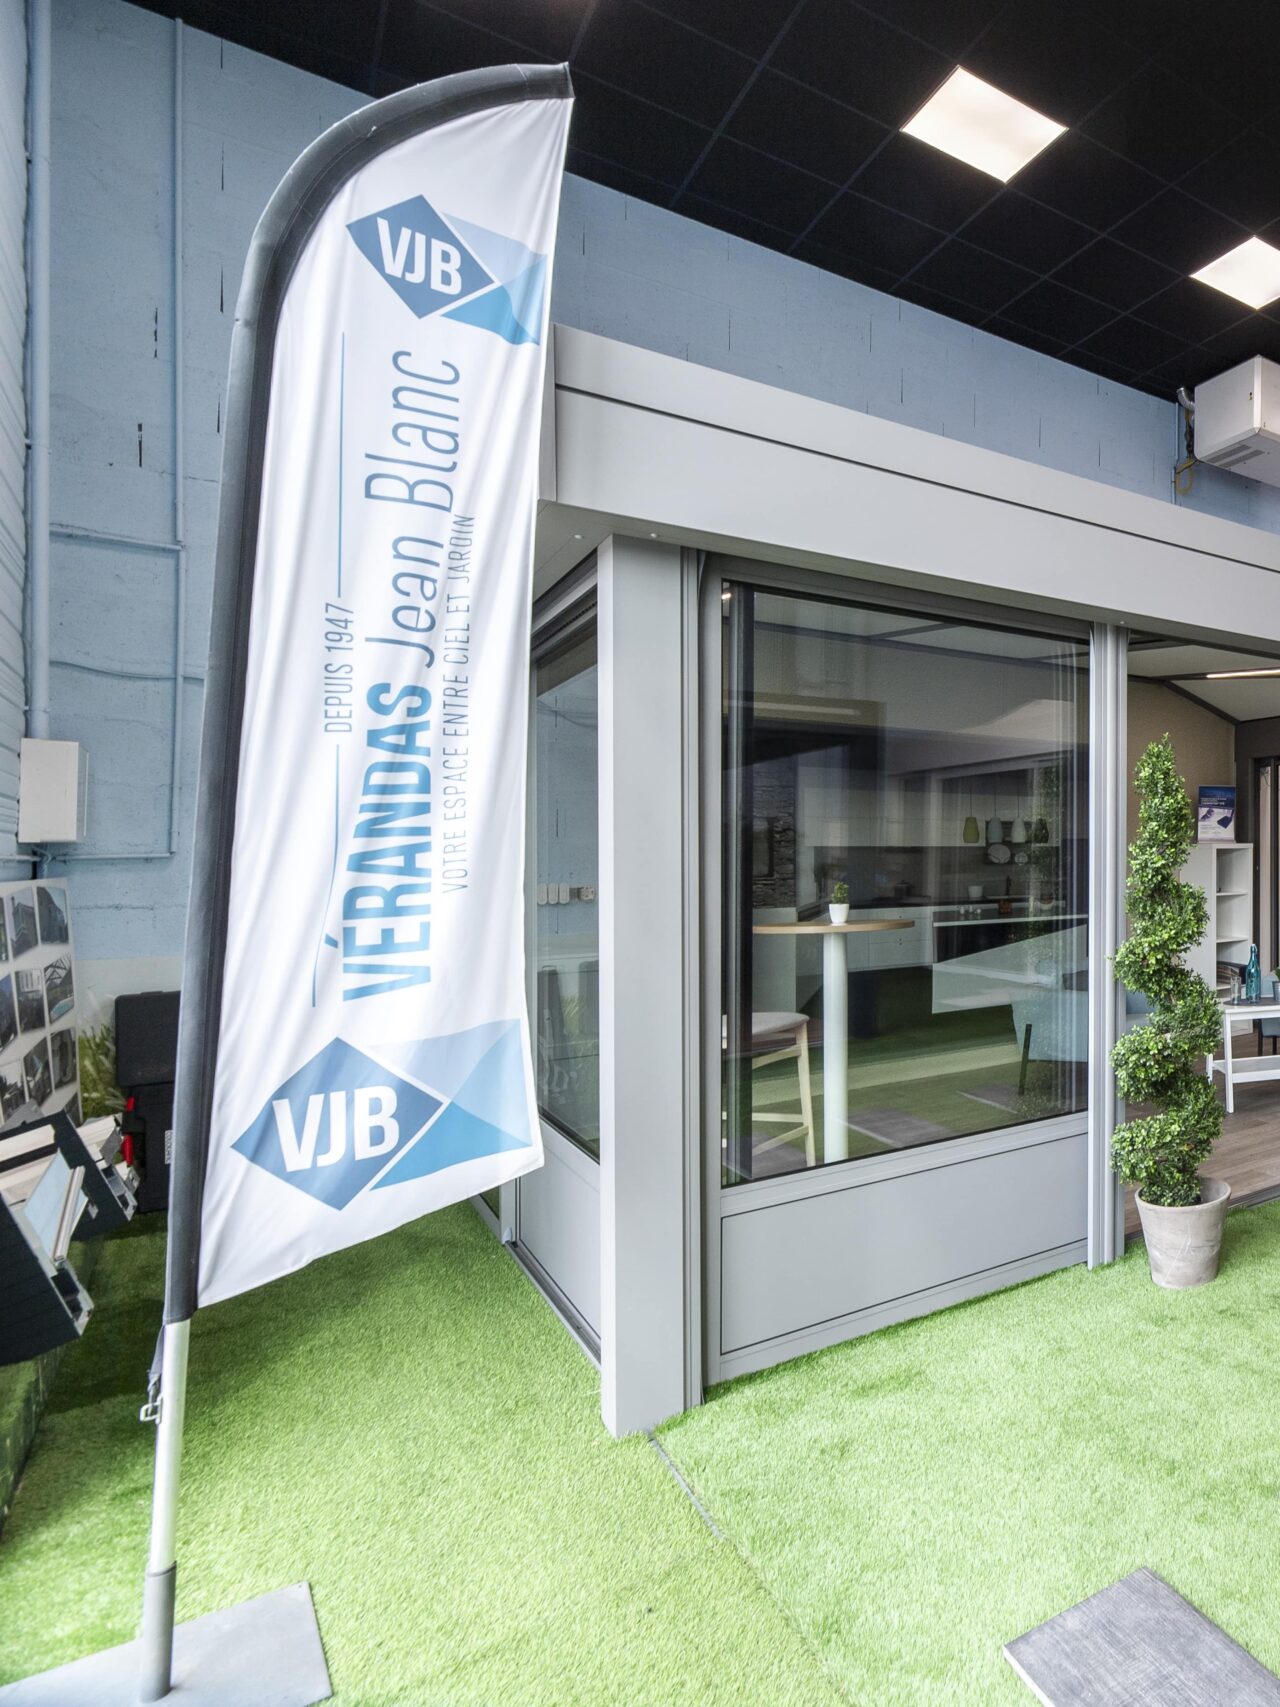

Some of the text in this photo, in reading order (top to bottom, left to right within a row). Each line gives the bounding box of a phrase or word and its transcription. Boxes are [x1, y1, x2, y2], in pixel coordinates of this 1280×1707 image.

[376, 216, 462, 295] VJB
[323, 602, 354, 734] DEPUIS 1947
[324, 350, 461, 1002] VÉRANDAS Jean Blanc
[441, 513, 476, 893] VOTRE ESPACE ENTRE CIEL ET JARDIN
[272, 1085, 400, 1173] VJB
